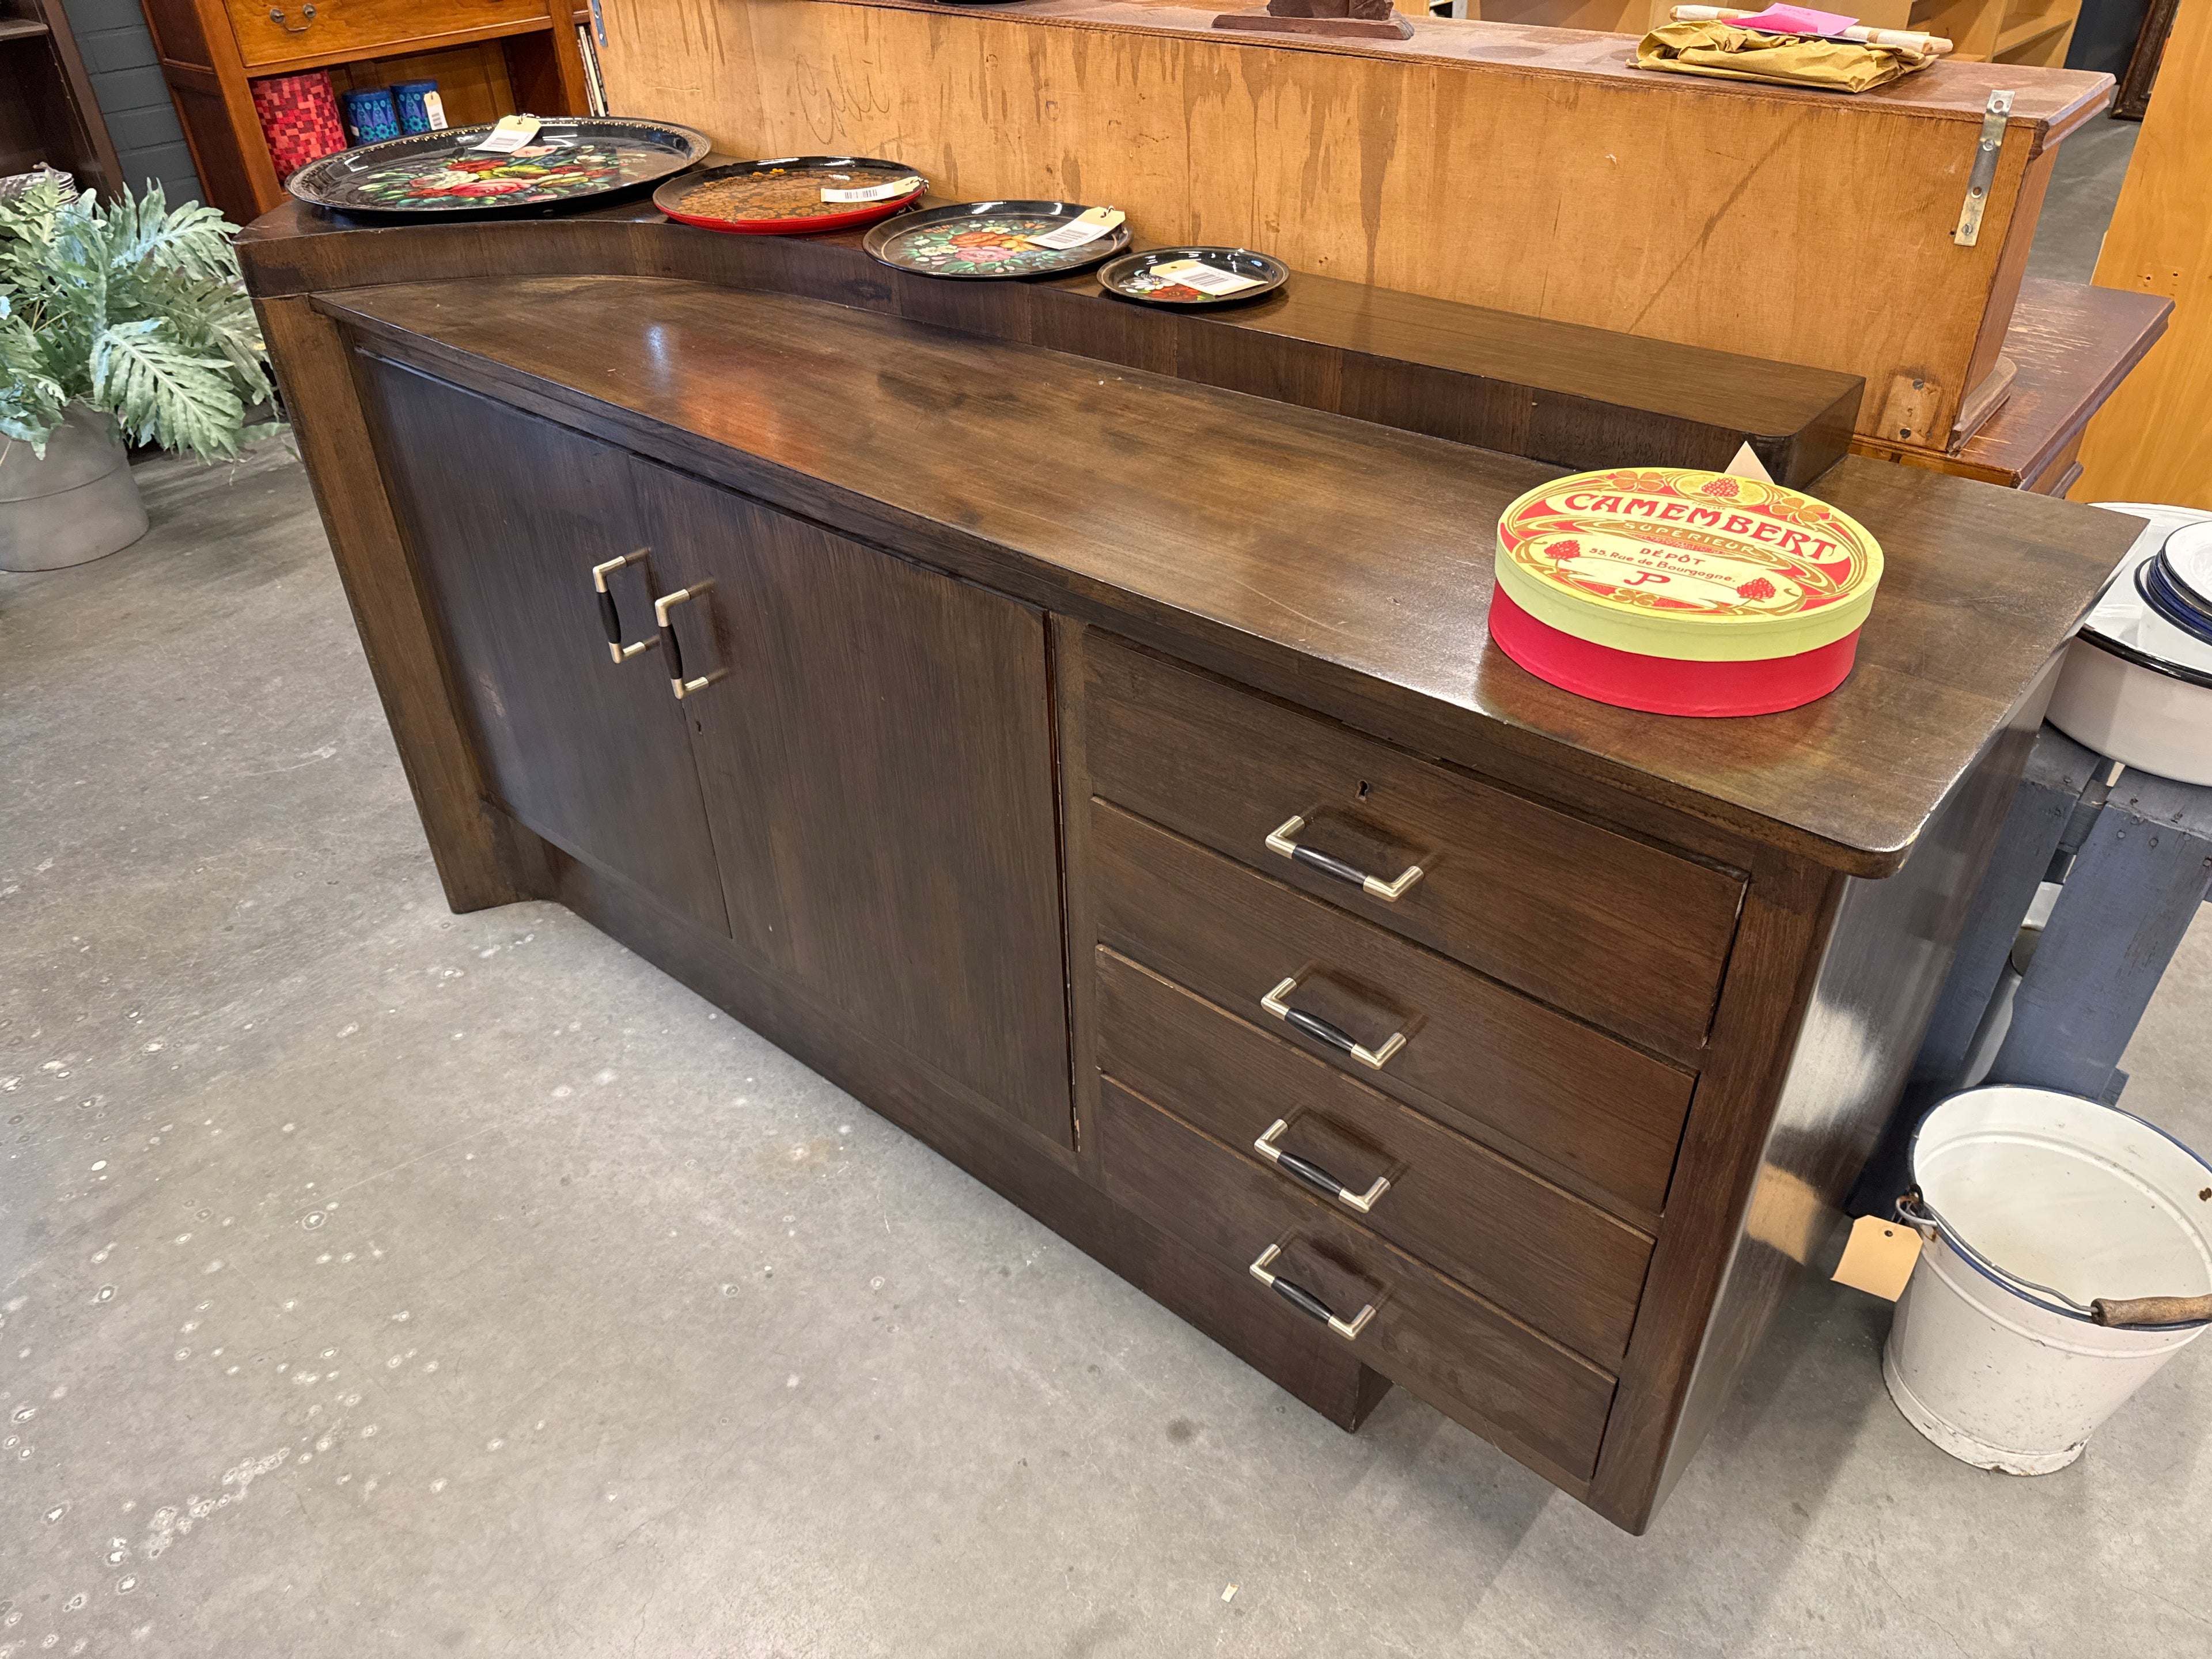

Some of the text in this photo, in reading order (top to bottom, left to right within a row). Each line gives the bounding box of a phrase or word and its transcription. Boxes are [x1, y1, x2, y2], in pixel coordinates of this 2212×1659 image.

[1565, 494, 1836, 560] CAMEMBERT
[1623, 522, 1760, 557] SUPÉRIEUR
[1610, 552, 1634, 562] Rue
[1657, 561, 1735, 582] Bourgogne.
[1639, 548, 1706, 565] DÉPÔT
